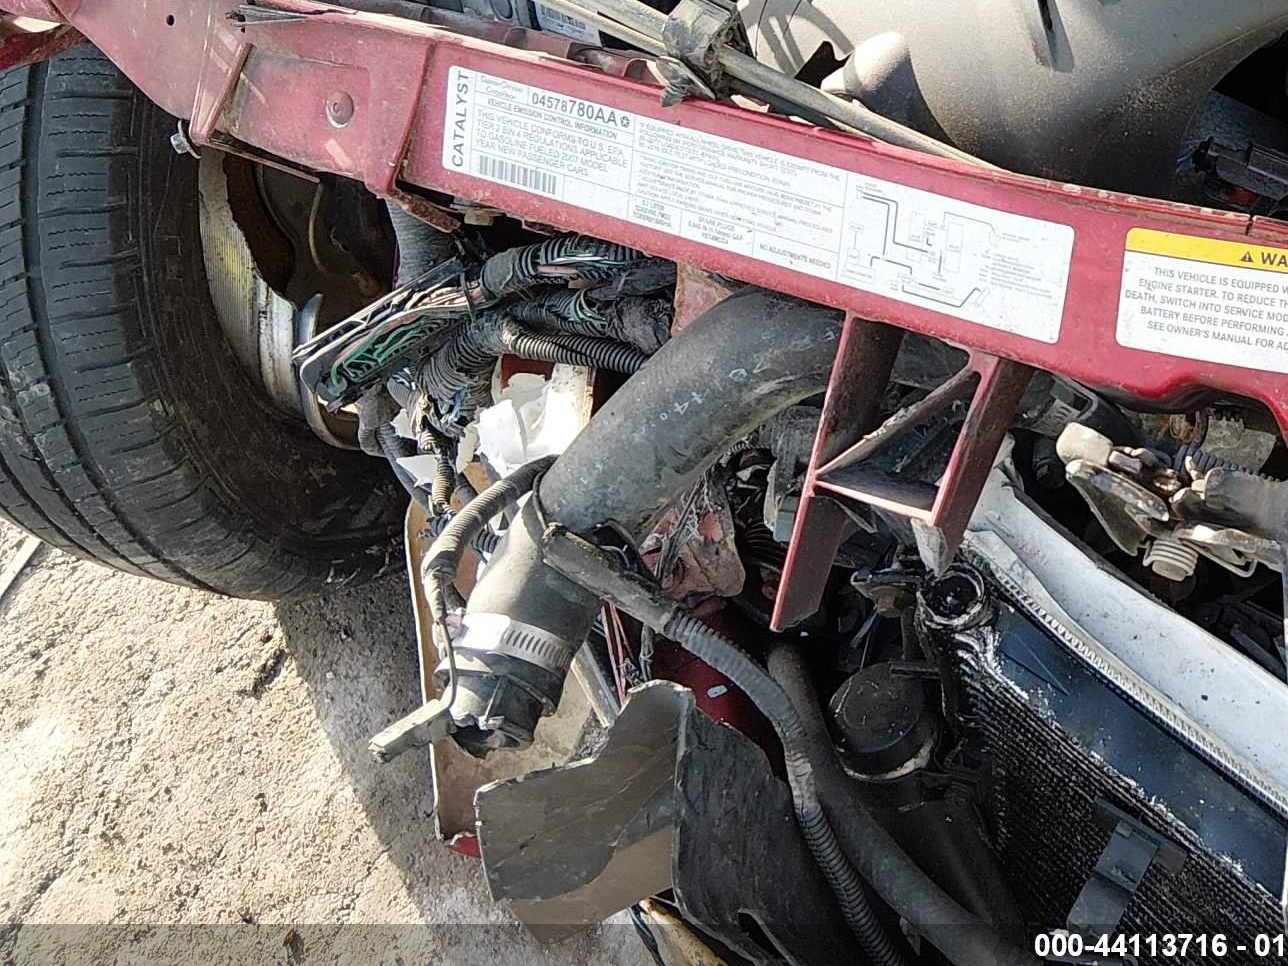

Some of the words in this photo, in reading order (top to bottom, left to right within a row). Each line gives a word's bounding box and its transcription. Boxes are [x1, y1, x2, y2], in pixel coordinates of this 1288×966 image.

[452, 70, 470, 167] CATALYST
[531, 91, 617, 126] 04578780AA
[1138, 278, 1173, 292] ENGINE
[1221, 289, 1234, 300] TO
[1236, 292, 1276, 306] REDUCE
[1154, 266, 1175, 279] THIS
[1177, 269, 1216, 285] VEHICLE
[1218, 275, 1229, 286] IS
[1230, 277, 1280, 293] EQUIPPED
[1124, 289, 1157, 303] DEATH,
[1160, 294, 1196, 308] SWITCH
[1198, 300, 1222, 312] INTO
[1223, 303, 1264, 318] SERVICE
[1140, 305, 1180, 320] BATTERY
[1182, 311, 1218, 326] BEFORE
[1220, 317, 1284, 335] PERFORMING
[1147, 320, 1164, 331] SEE
[1211, 329, 1250, 344] MANUAL
[1254, 336, 1274, 347] FOR
